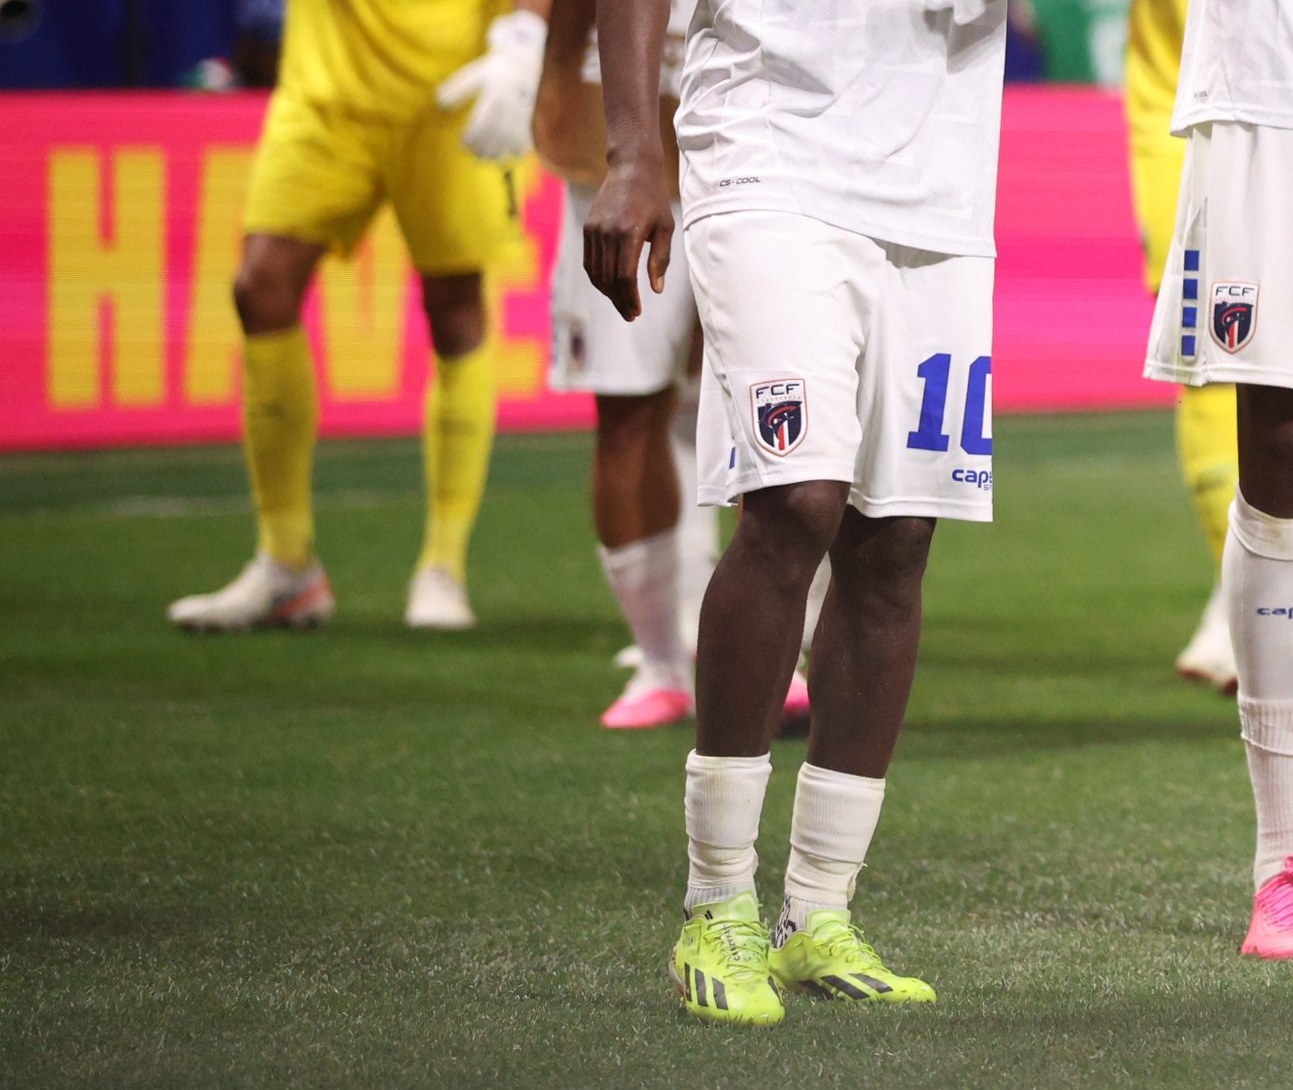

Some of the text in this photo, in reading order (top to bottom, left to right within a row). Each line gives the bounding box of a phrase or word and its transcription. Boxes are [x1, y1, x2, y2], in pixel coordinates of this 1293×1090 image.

[1216, 286, 1254, 296] FCF
[756, 384, 800, 399] FCF
[907, 353, 992, 455] 10
